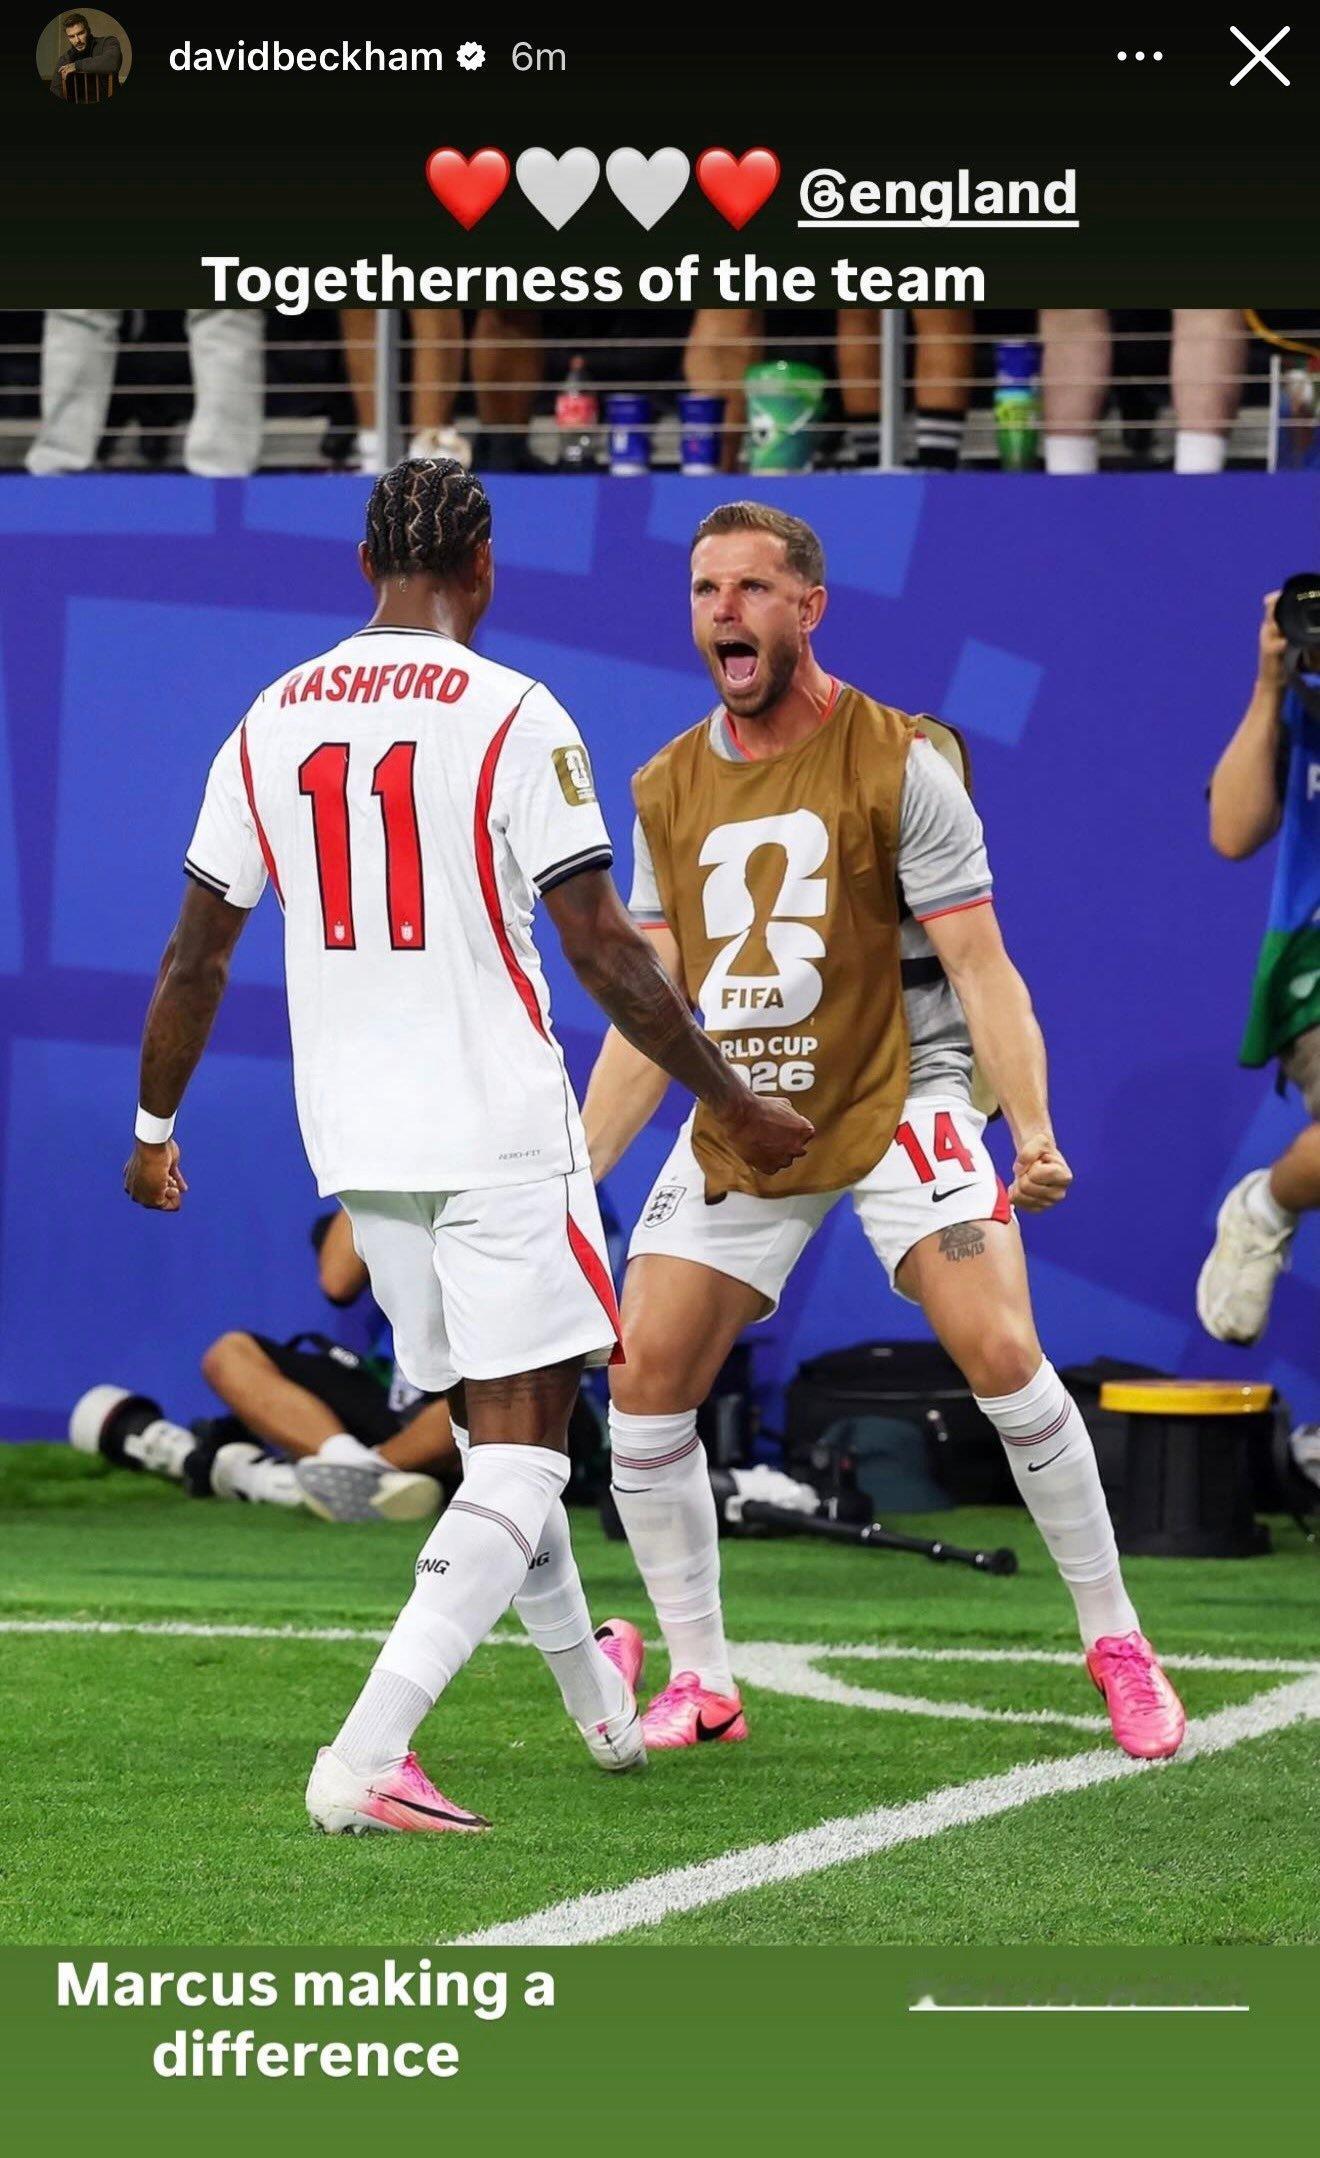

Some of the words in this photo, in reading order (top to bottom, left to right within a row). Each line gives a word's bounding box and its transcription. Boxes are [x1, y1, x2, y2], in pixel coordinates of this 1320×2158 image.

[280, 663, 470, 708] RASHFORD
[298, 740, 426, 951] 11
[721, 987, 784, 1010] FIFA
[720, 1037, 765, 1059] RLD
[767, 1036, 818, 1057] CUP
[893, 1111, 977, 1184] 14
